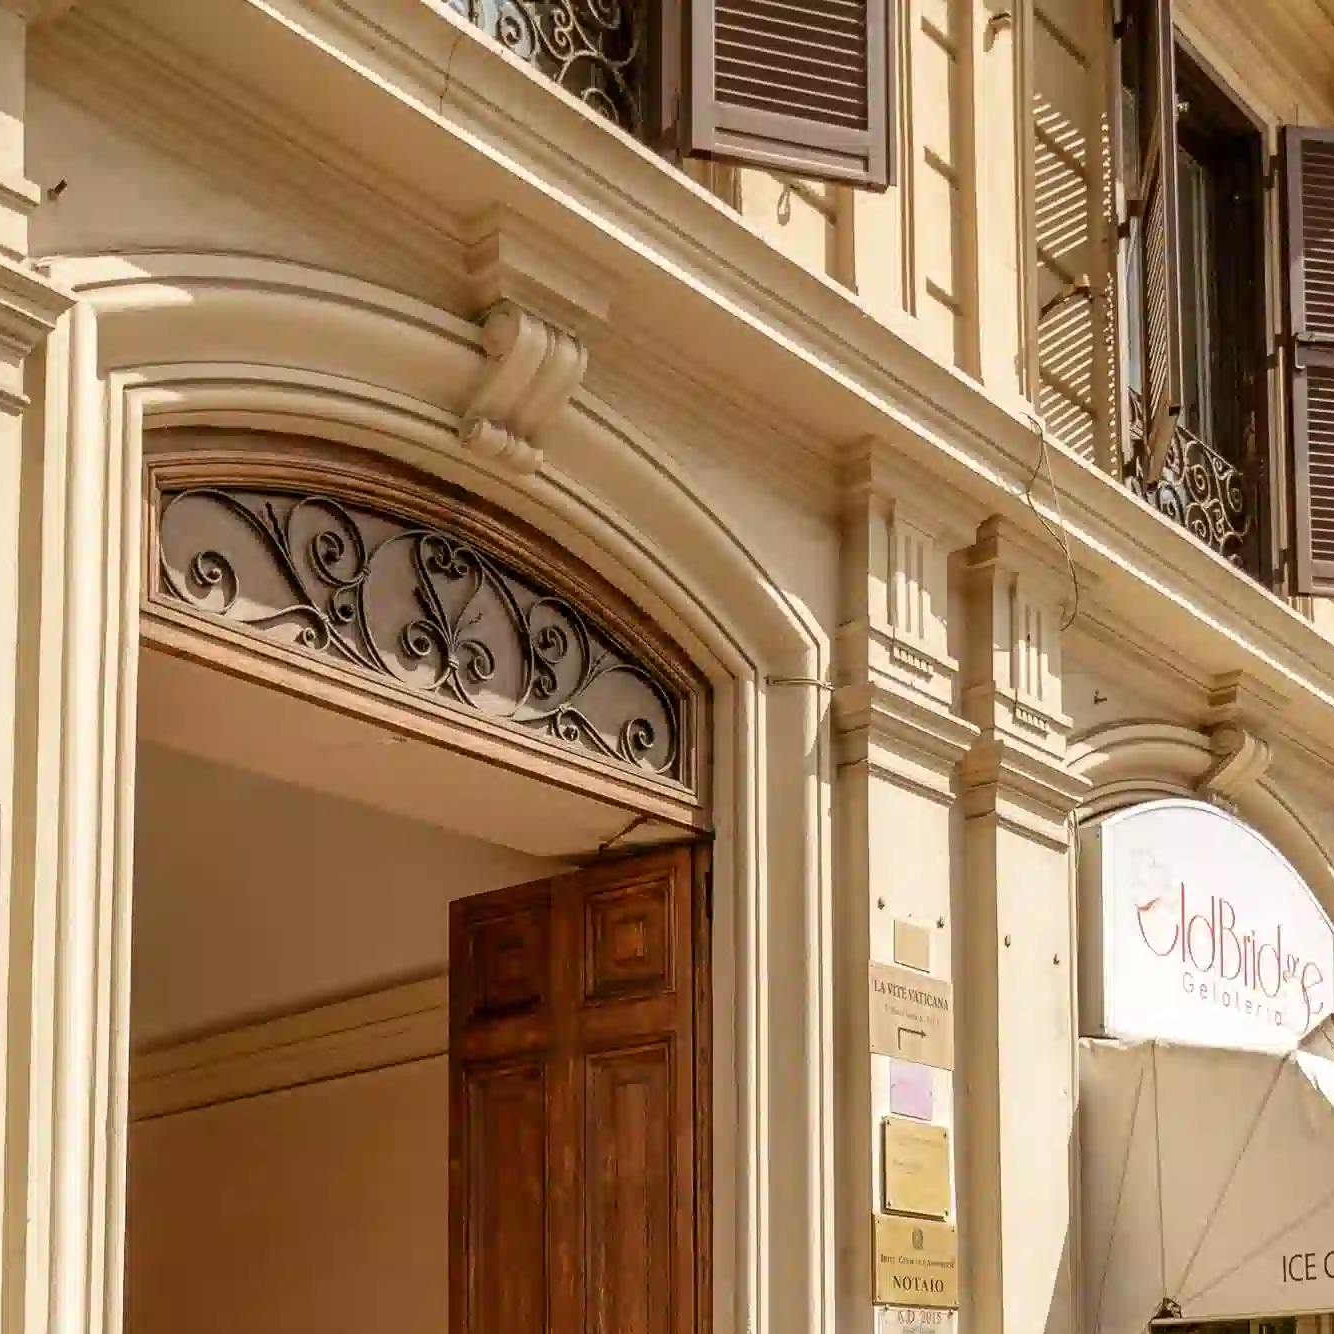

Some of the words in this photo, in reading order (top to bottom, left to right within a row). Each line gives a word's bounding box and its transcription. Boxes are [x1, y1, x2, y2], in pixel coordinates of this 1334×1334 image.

[873, 979, 886, 994] LA
[887, 982, 908, 1000] VITE
[907, 988, 949, 1011] VATICANA
[1282, 1252, 1317, 1283] ICE
[893, 1275, 944, 1293] NOTAIO
